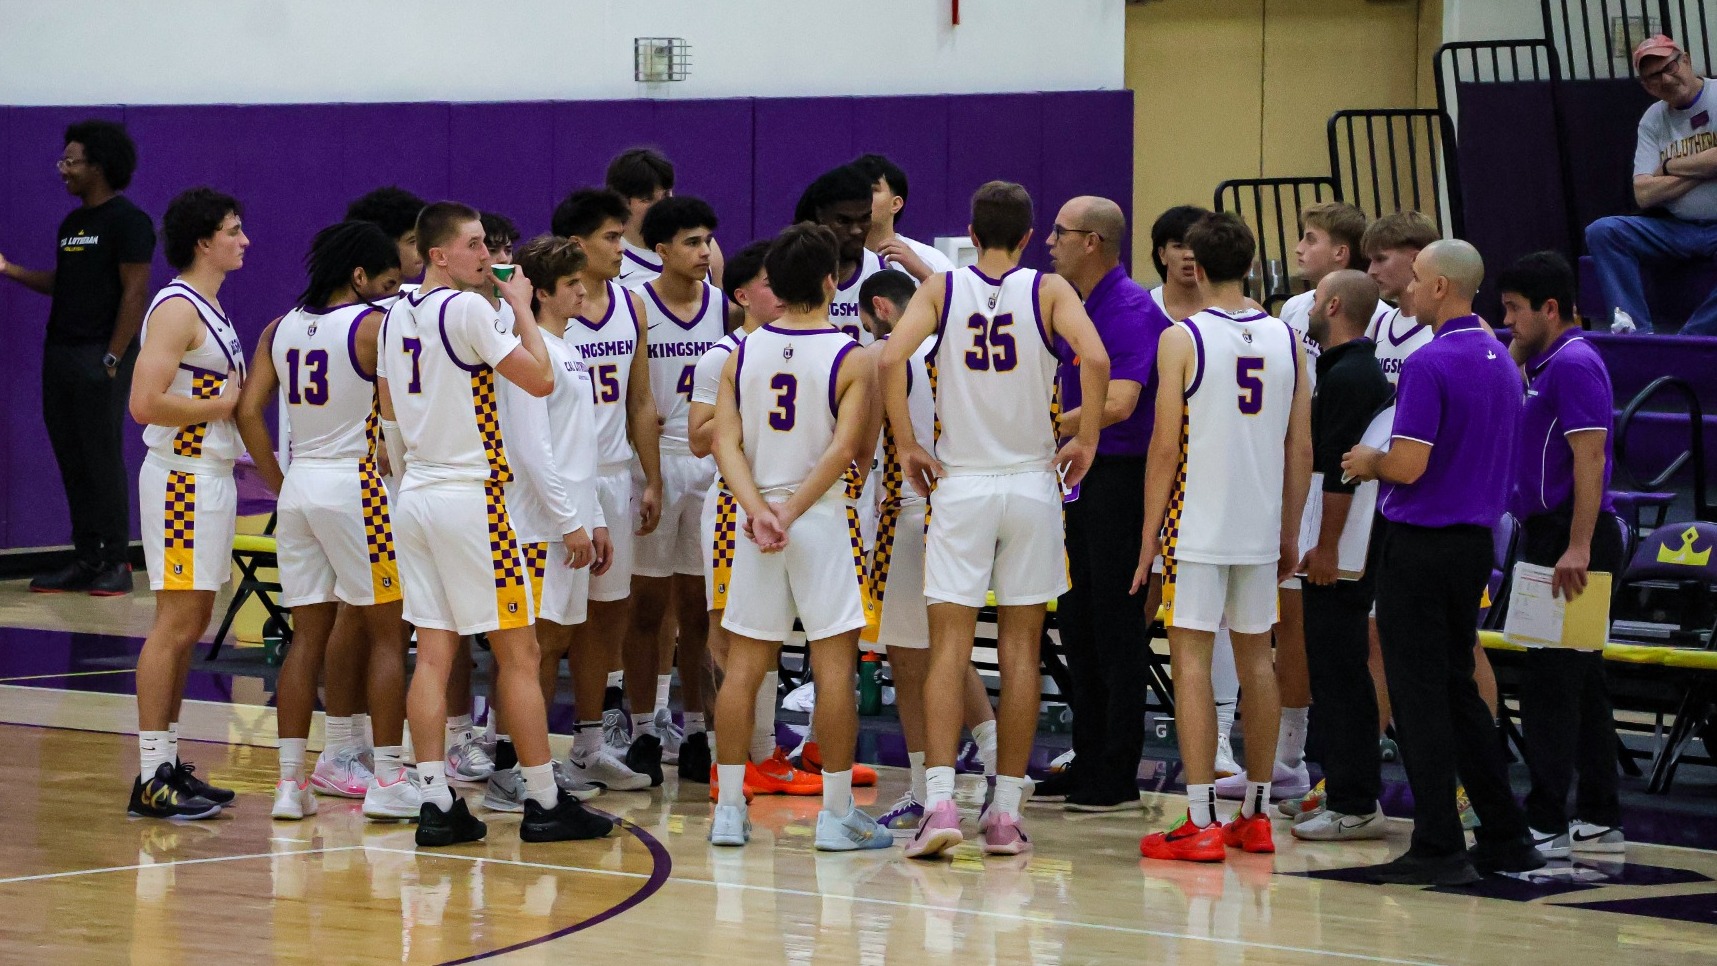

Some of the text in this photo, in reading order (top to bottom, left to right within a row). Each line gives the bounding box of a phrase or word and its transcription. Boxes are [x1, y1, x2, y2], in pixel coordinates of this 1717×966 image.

[828, 302, 859, 316] GSM
[402, 336, 422, 395] 7
[963, 311, 1020, 374] 35
[285, 348, 329, 407] 13
[588, 362, 620, 404] 15
[675, 363, 697, 403] 4
[768, 371, 798, 432] 3
[1235, 355, 1265, 416] 5
